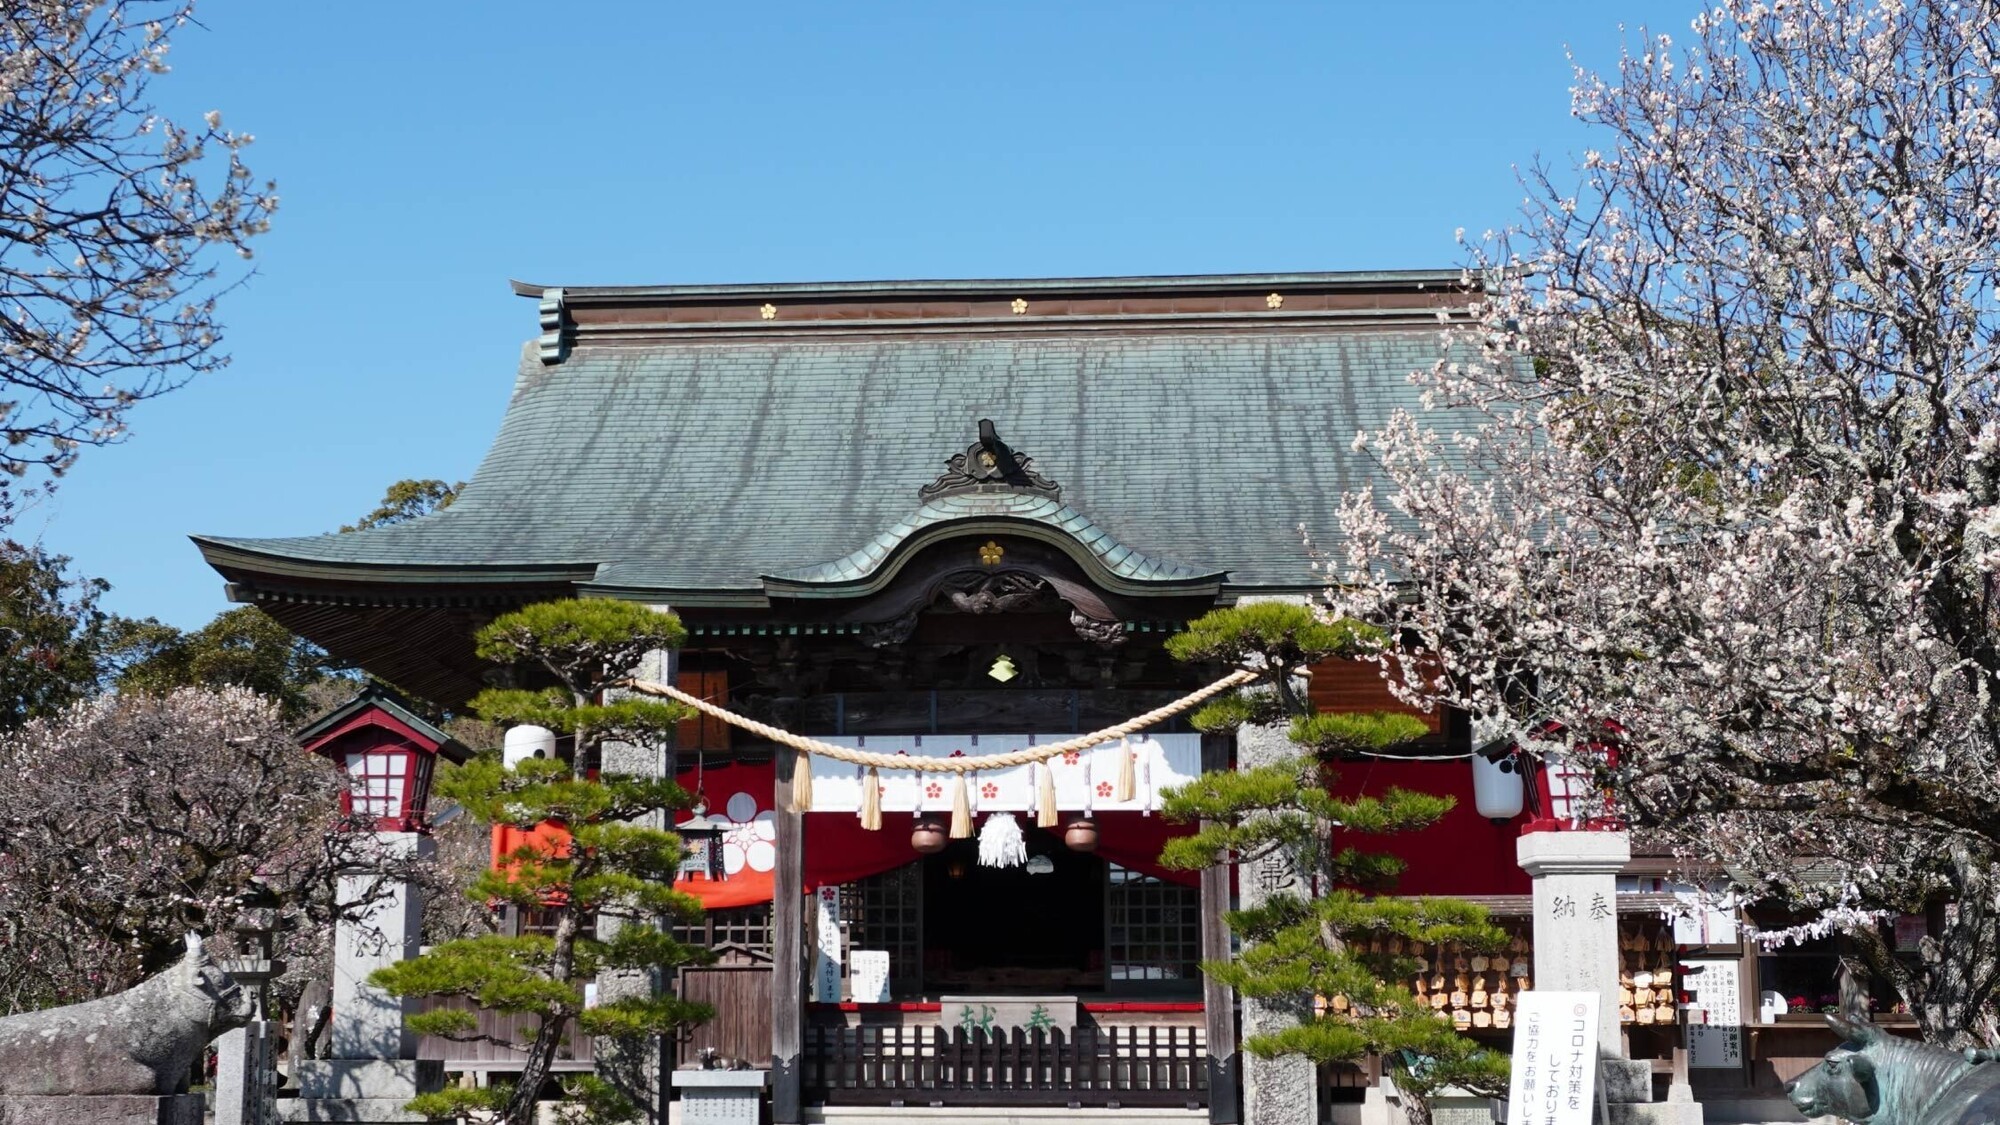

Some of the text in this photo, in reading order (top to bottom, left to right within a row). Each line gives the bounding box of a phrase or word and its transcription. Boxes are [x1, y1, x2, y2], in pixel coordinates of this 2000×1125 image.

[1568, 1019, 1585, 1110] コロナ対策を
